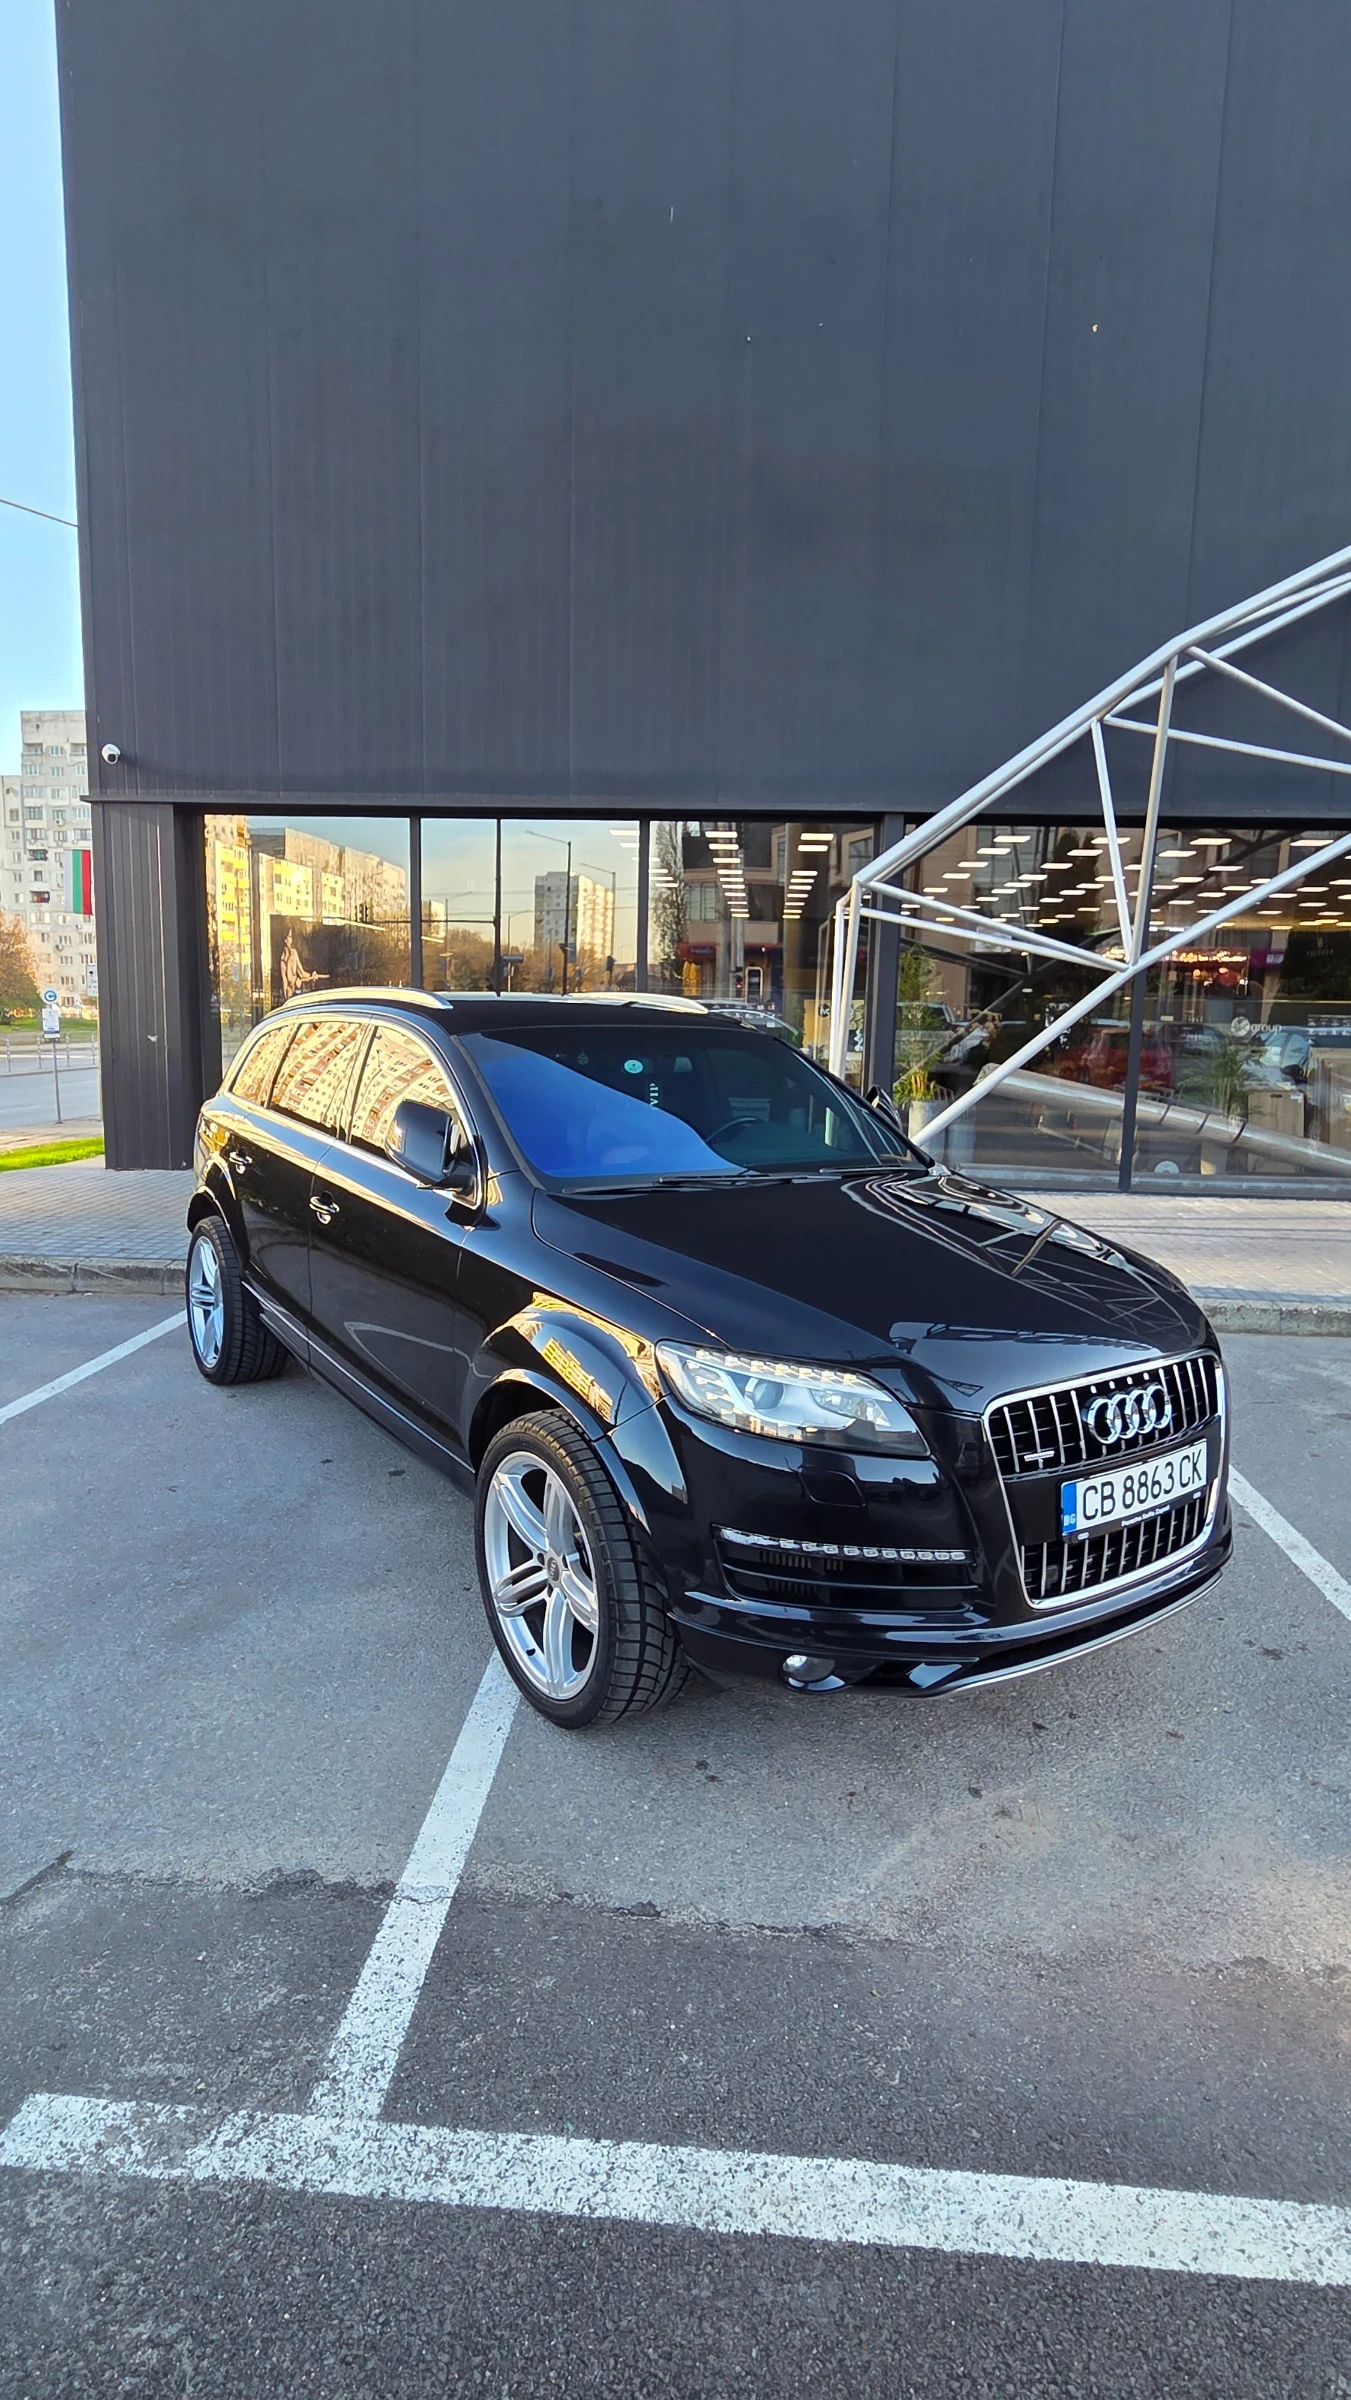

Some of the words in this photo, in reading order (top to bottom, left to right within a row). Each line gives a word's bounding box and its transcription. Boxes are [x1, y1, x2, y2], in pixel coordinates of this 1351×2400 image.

[1251, 1023, 1282, 1035] group
[1082, 1481, 1116, 1520] CB
[1122, 1461, 1175, 1509] 8863
[1179, 1449, 1203, 1488] CK
[1063, 1513, 1076, 1526] BG
